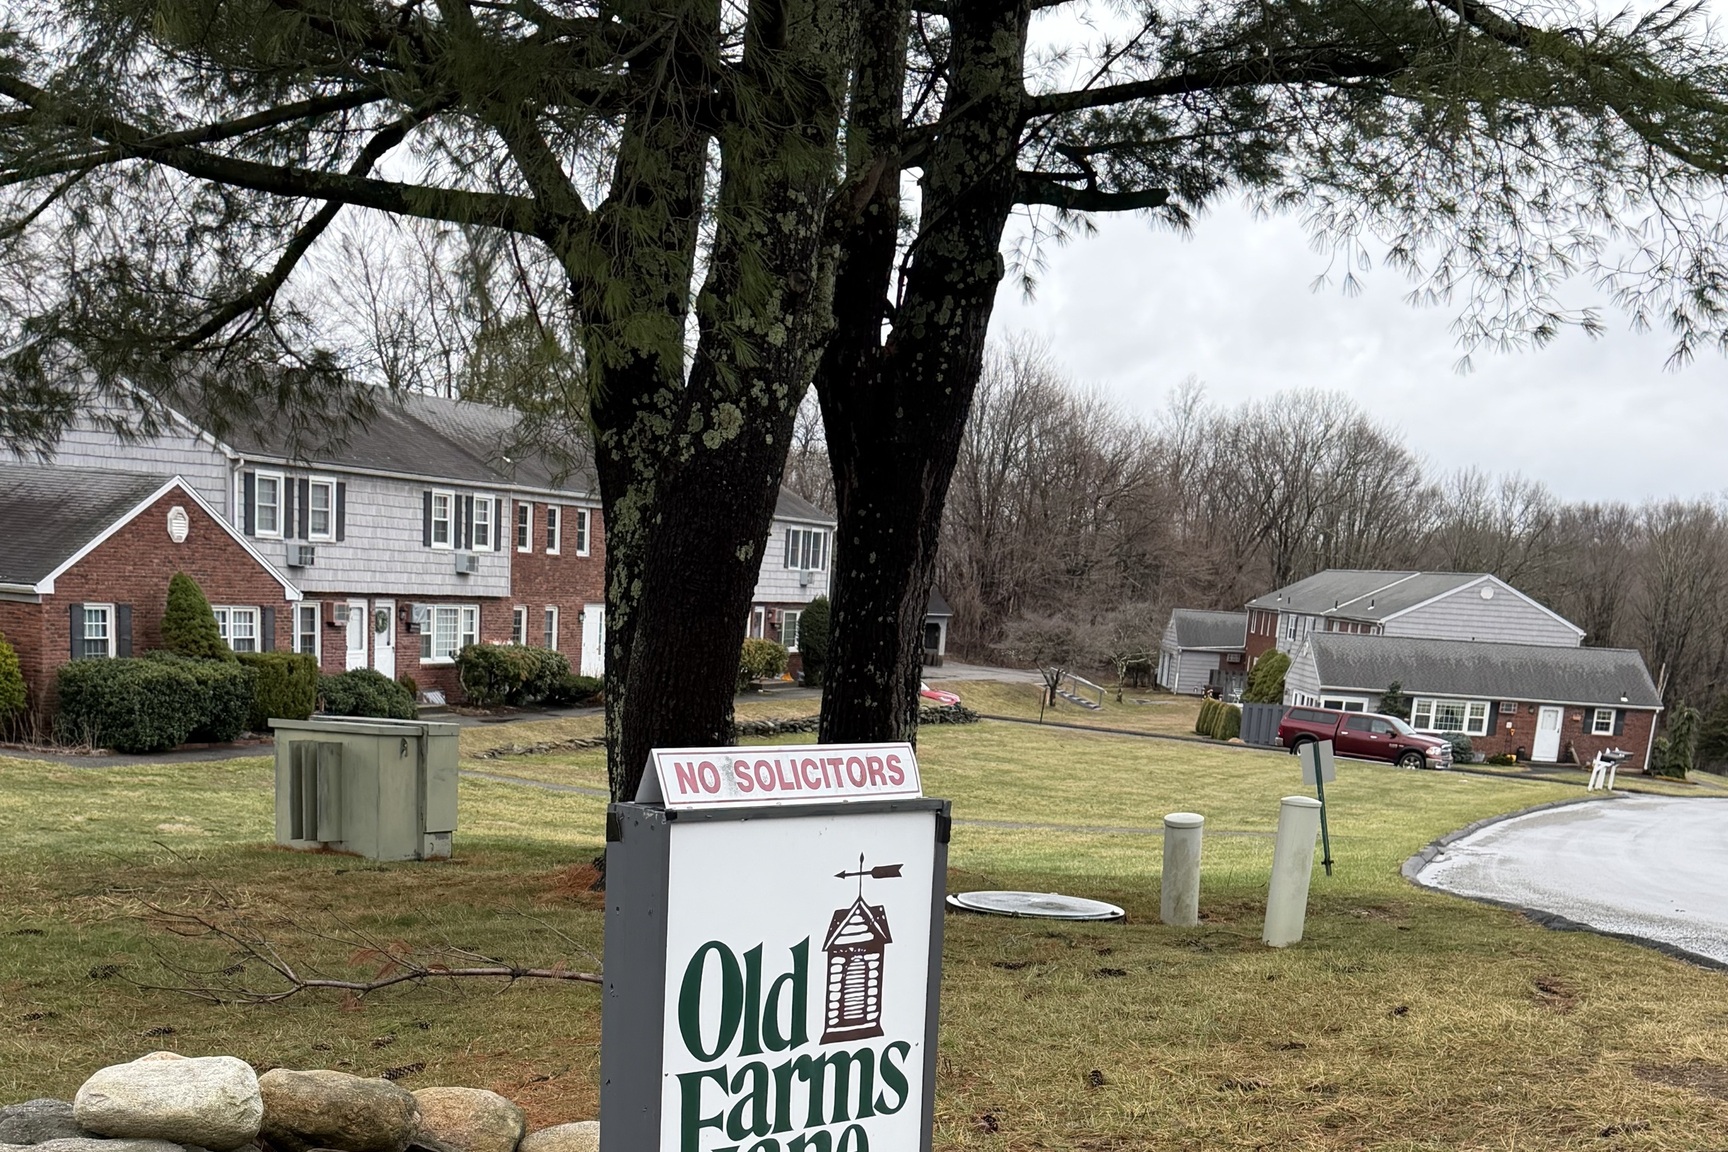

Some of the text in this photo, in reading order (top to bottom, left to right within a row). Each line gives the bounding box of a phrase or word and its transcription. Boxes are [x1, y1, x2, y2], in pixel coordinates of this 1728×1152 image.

[673, 754, 905, 795] NO SOLICITORS
[677, 935, 810, 1063] Old
